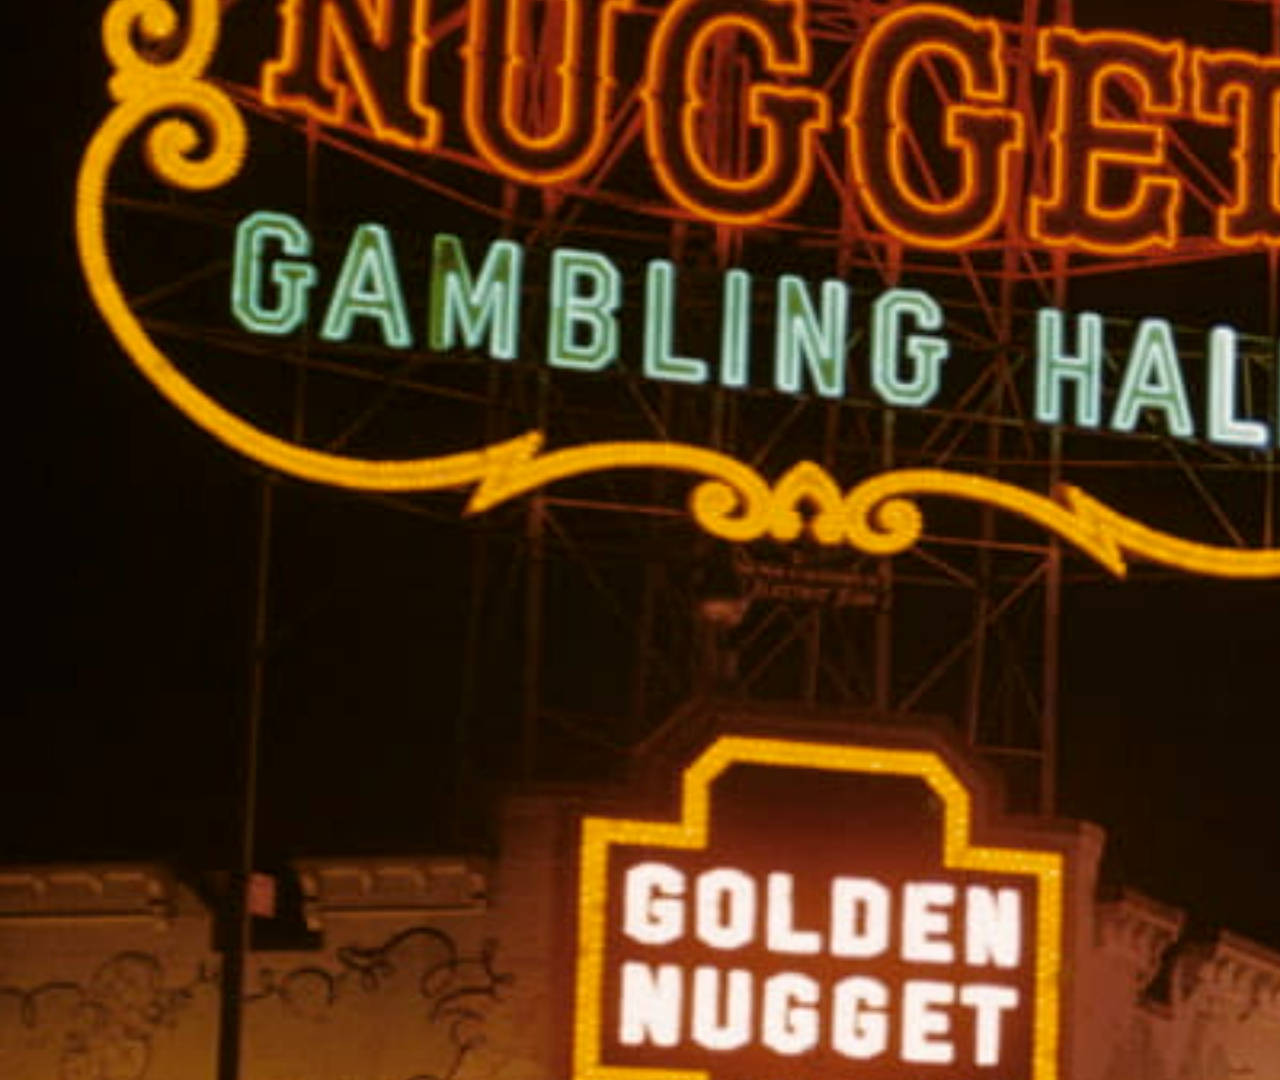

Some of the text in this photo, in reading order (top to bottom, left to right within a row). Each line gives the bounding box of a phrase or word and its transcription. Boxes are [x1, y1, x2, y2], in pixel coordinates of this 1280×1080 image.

[230, 211, 950, 405] GAMBLING
[622, 861, 1023, 969] GOLDEN
[618, 960, 1020, 1067] NUGGET
